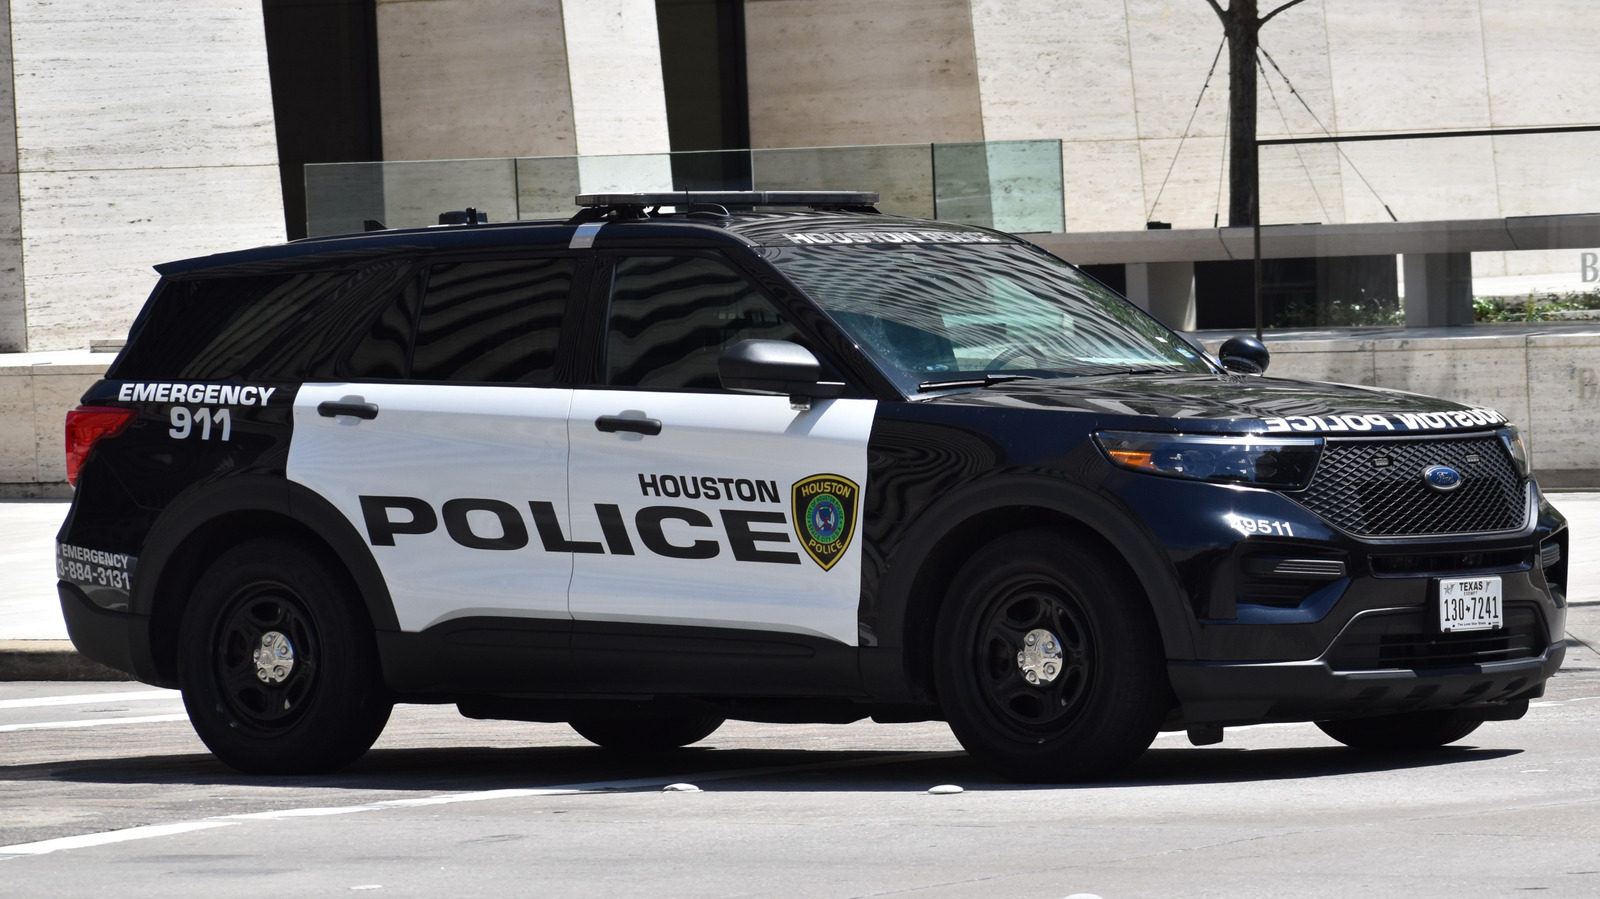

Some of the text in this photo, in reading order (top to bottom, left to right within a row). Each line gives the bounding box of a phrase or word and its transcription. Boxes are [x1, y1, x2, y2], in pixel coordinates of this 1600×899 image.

[782, 232, 925, 244] HOUSTON
[118, 383, 276, 406] EMERGENCY
[169, 407, 232, 441] 911
[638, 473, 781, 503] HOUSTON
[801, 481, 852, 499] HOUSTON
[358, 495, 801, 565] POLICE
[1230, 519, 1294, 536] 49511
[62, 543, 128, 569] EMERGENCY
[808, 538, 843, 555] POLICE
[1459, 581, 1483, 592] TEXAS
